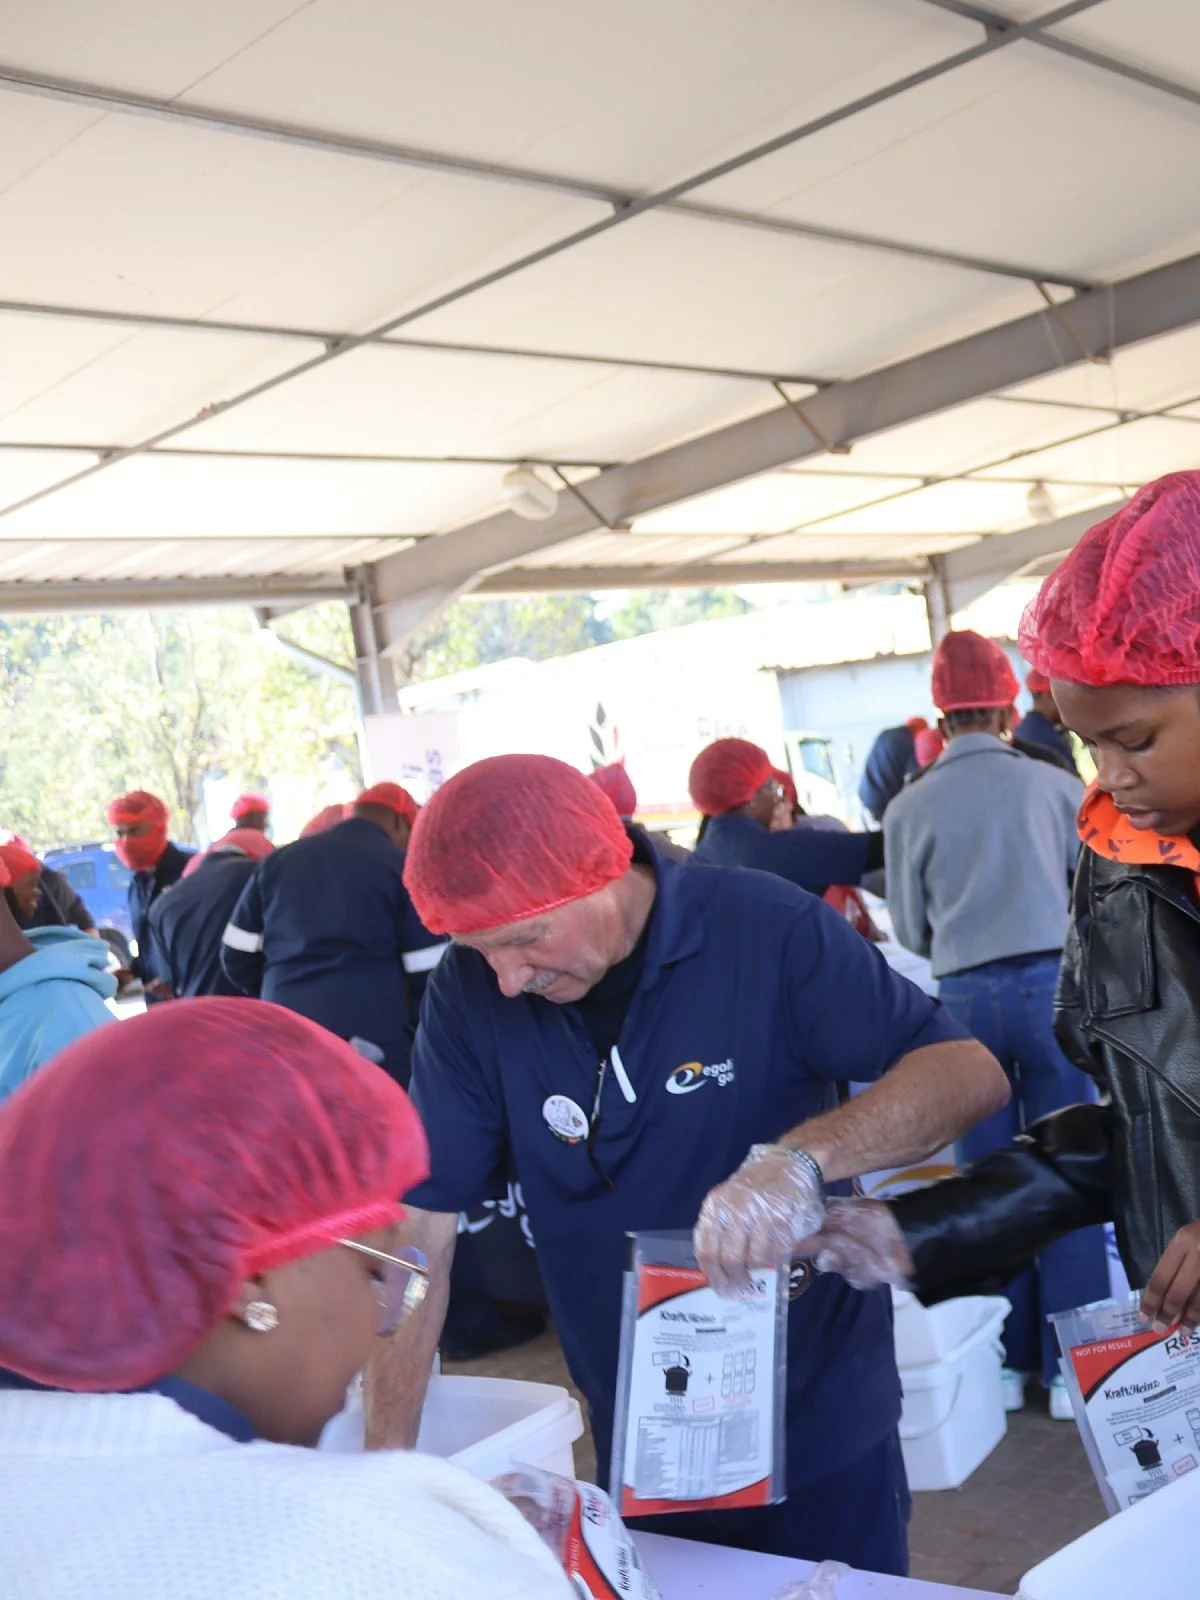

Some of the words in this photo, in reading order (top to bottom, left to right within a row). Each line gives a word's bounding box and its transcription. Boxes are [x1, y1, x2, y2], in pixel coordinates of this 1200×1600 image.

[1075, 1348, 1092, 1358] NOT
[1093, 1345, 1107, 1354] FOR
[1108, 1340, 1133, 1351] RESALE
